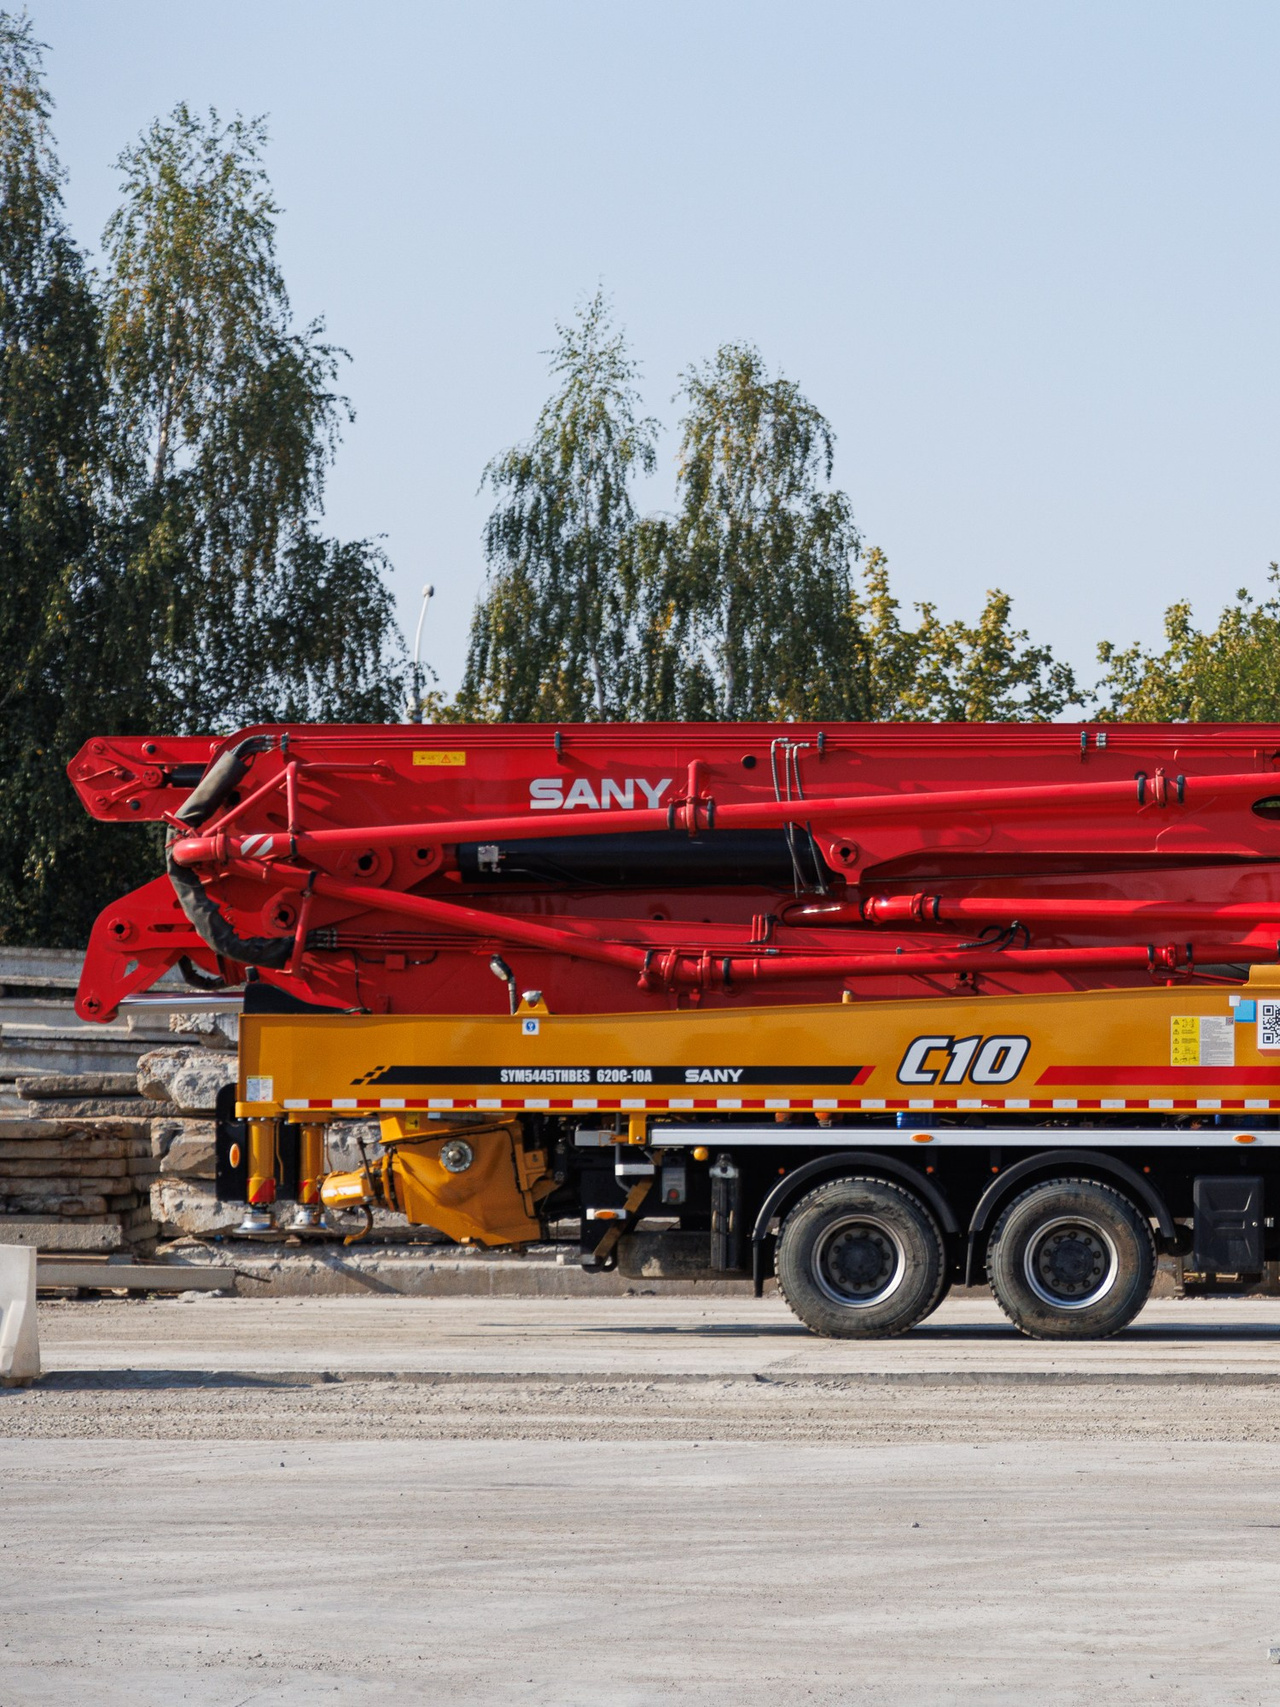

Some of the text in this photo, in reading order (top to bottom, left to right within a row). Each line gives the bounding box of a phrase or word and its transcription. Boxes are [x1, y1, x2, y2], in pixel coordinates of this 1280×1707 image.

[529, 778, 673, 809] SANY
[896, 1035, 1031, 1085] C10
[500, 1069, 743, 1083] SYM5445THBES 620C-10A SANY
